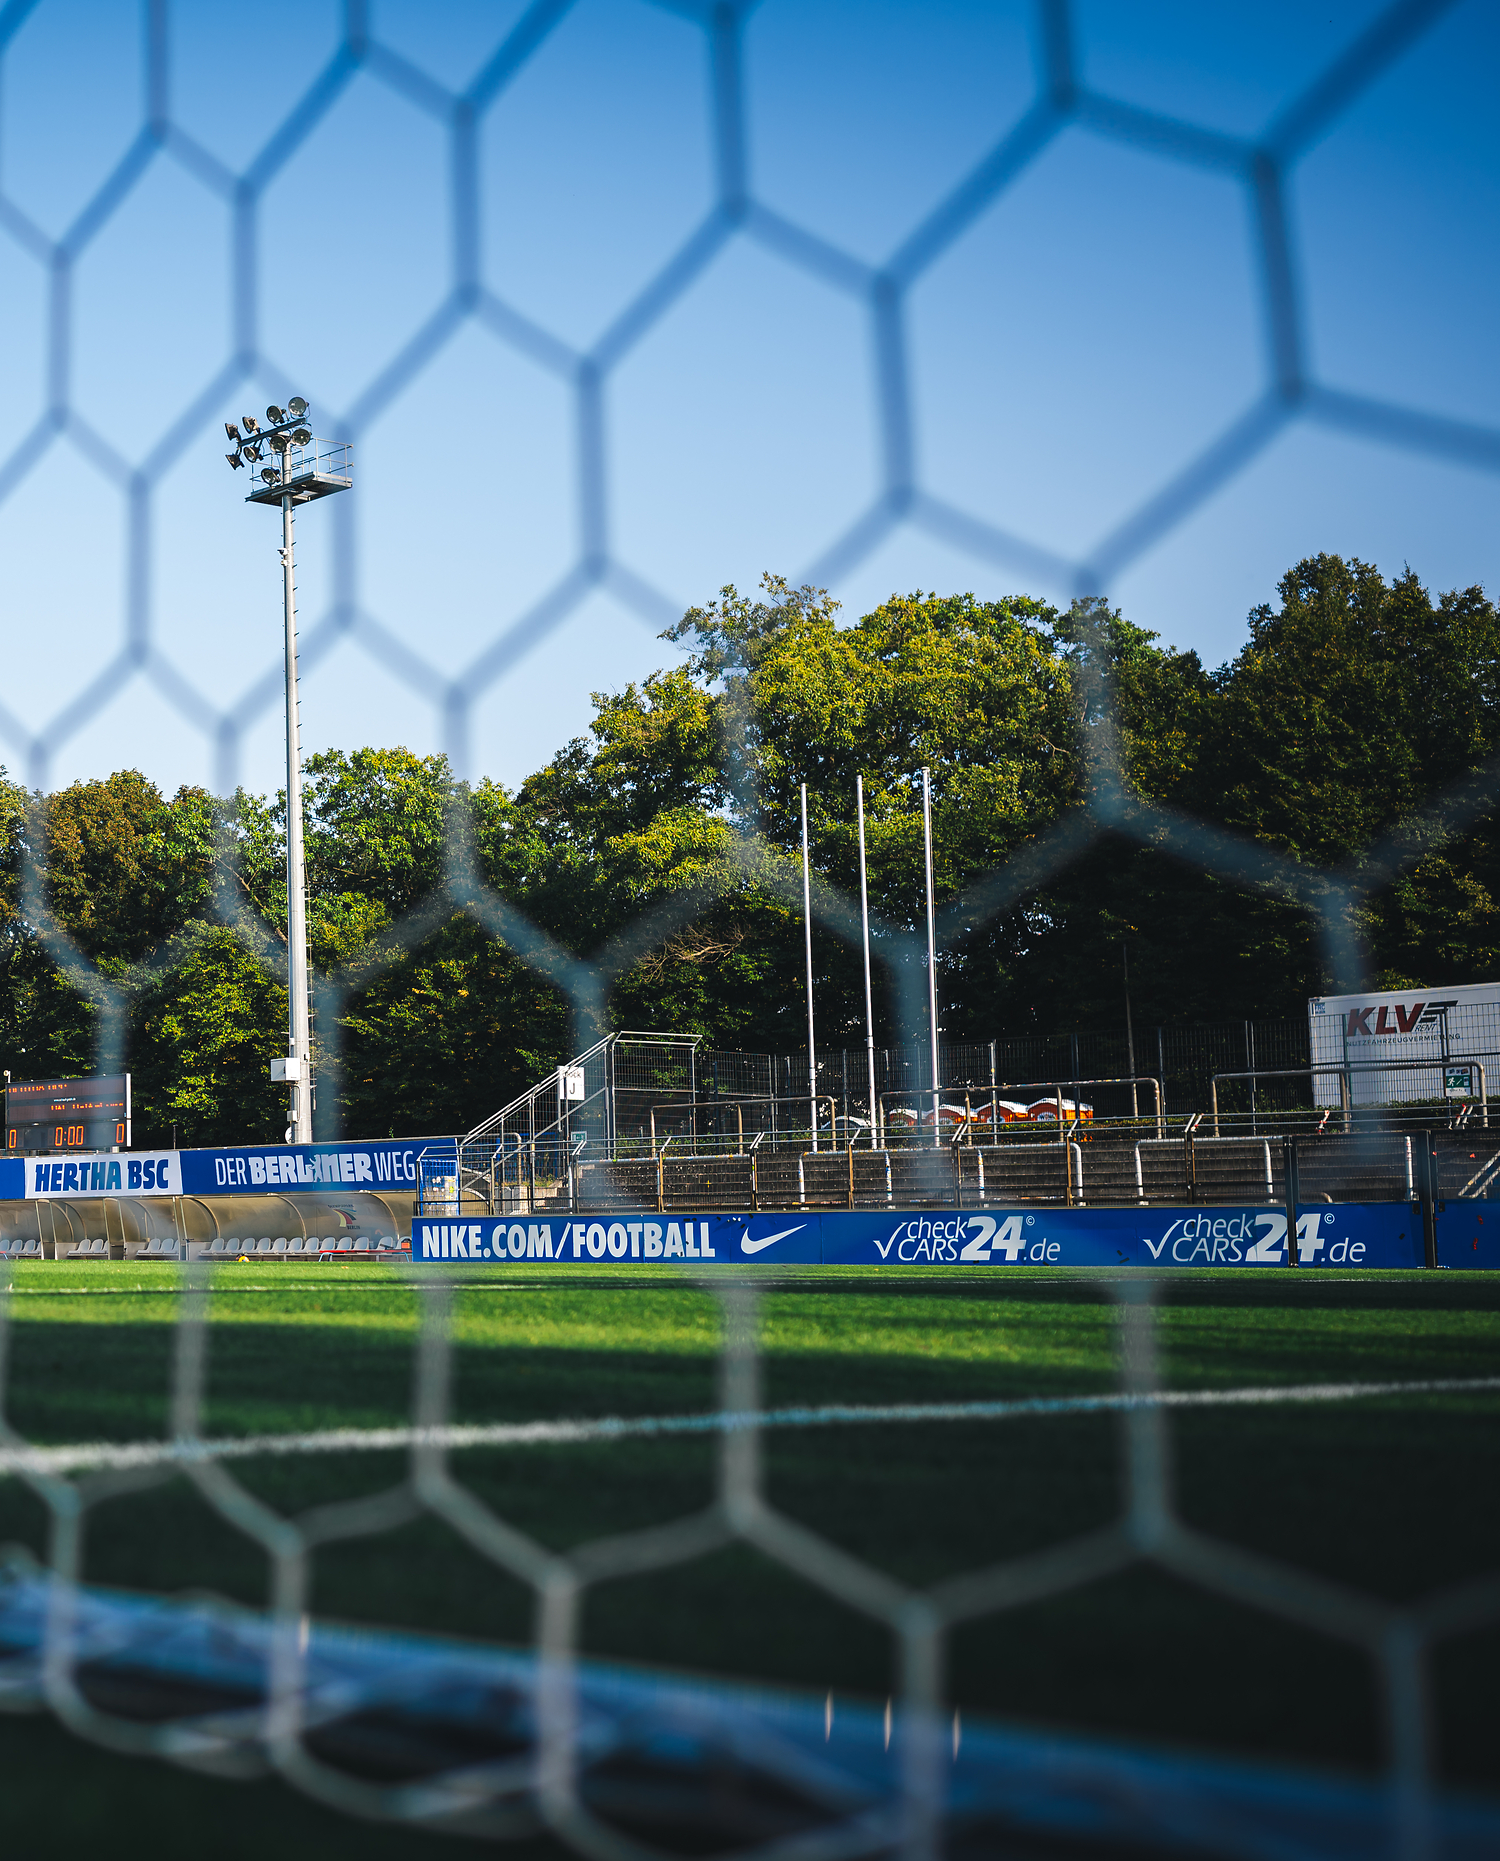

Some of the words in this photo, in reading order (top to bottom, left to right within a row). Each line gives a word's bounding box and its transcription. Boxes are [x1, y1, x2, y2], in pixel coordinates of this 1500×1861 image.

[1346, 1003, 1426, 1037] KLV
[1415, 1023, 1438, 1032] RENT
[569, 1083, 576, 1095] J
[9, 1129, 17, 1148] 0
[55, 1126, 84, 1147] 0:00
[116, 1123, 125, 1143] 0
[34, 1161, 123, 1192] HERTHA
[128, 1159, 169, 1190] BSC
[214, 1157, 247, 1186] DER
[374, 1150, 416, 1181] WEG
[907, 1216, 968, 1239] check
[1183, 1213, 1255, 1238] check
[422, 1222, 716, 1259] NIKE.COM/FOOTBALL
[898, 1238, 959, 1261] CARS
[1172, 1237, 1244, 1262] CARS
